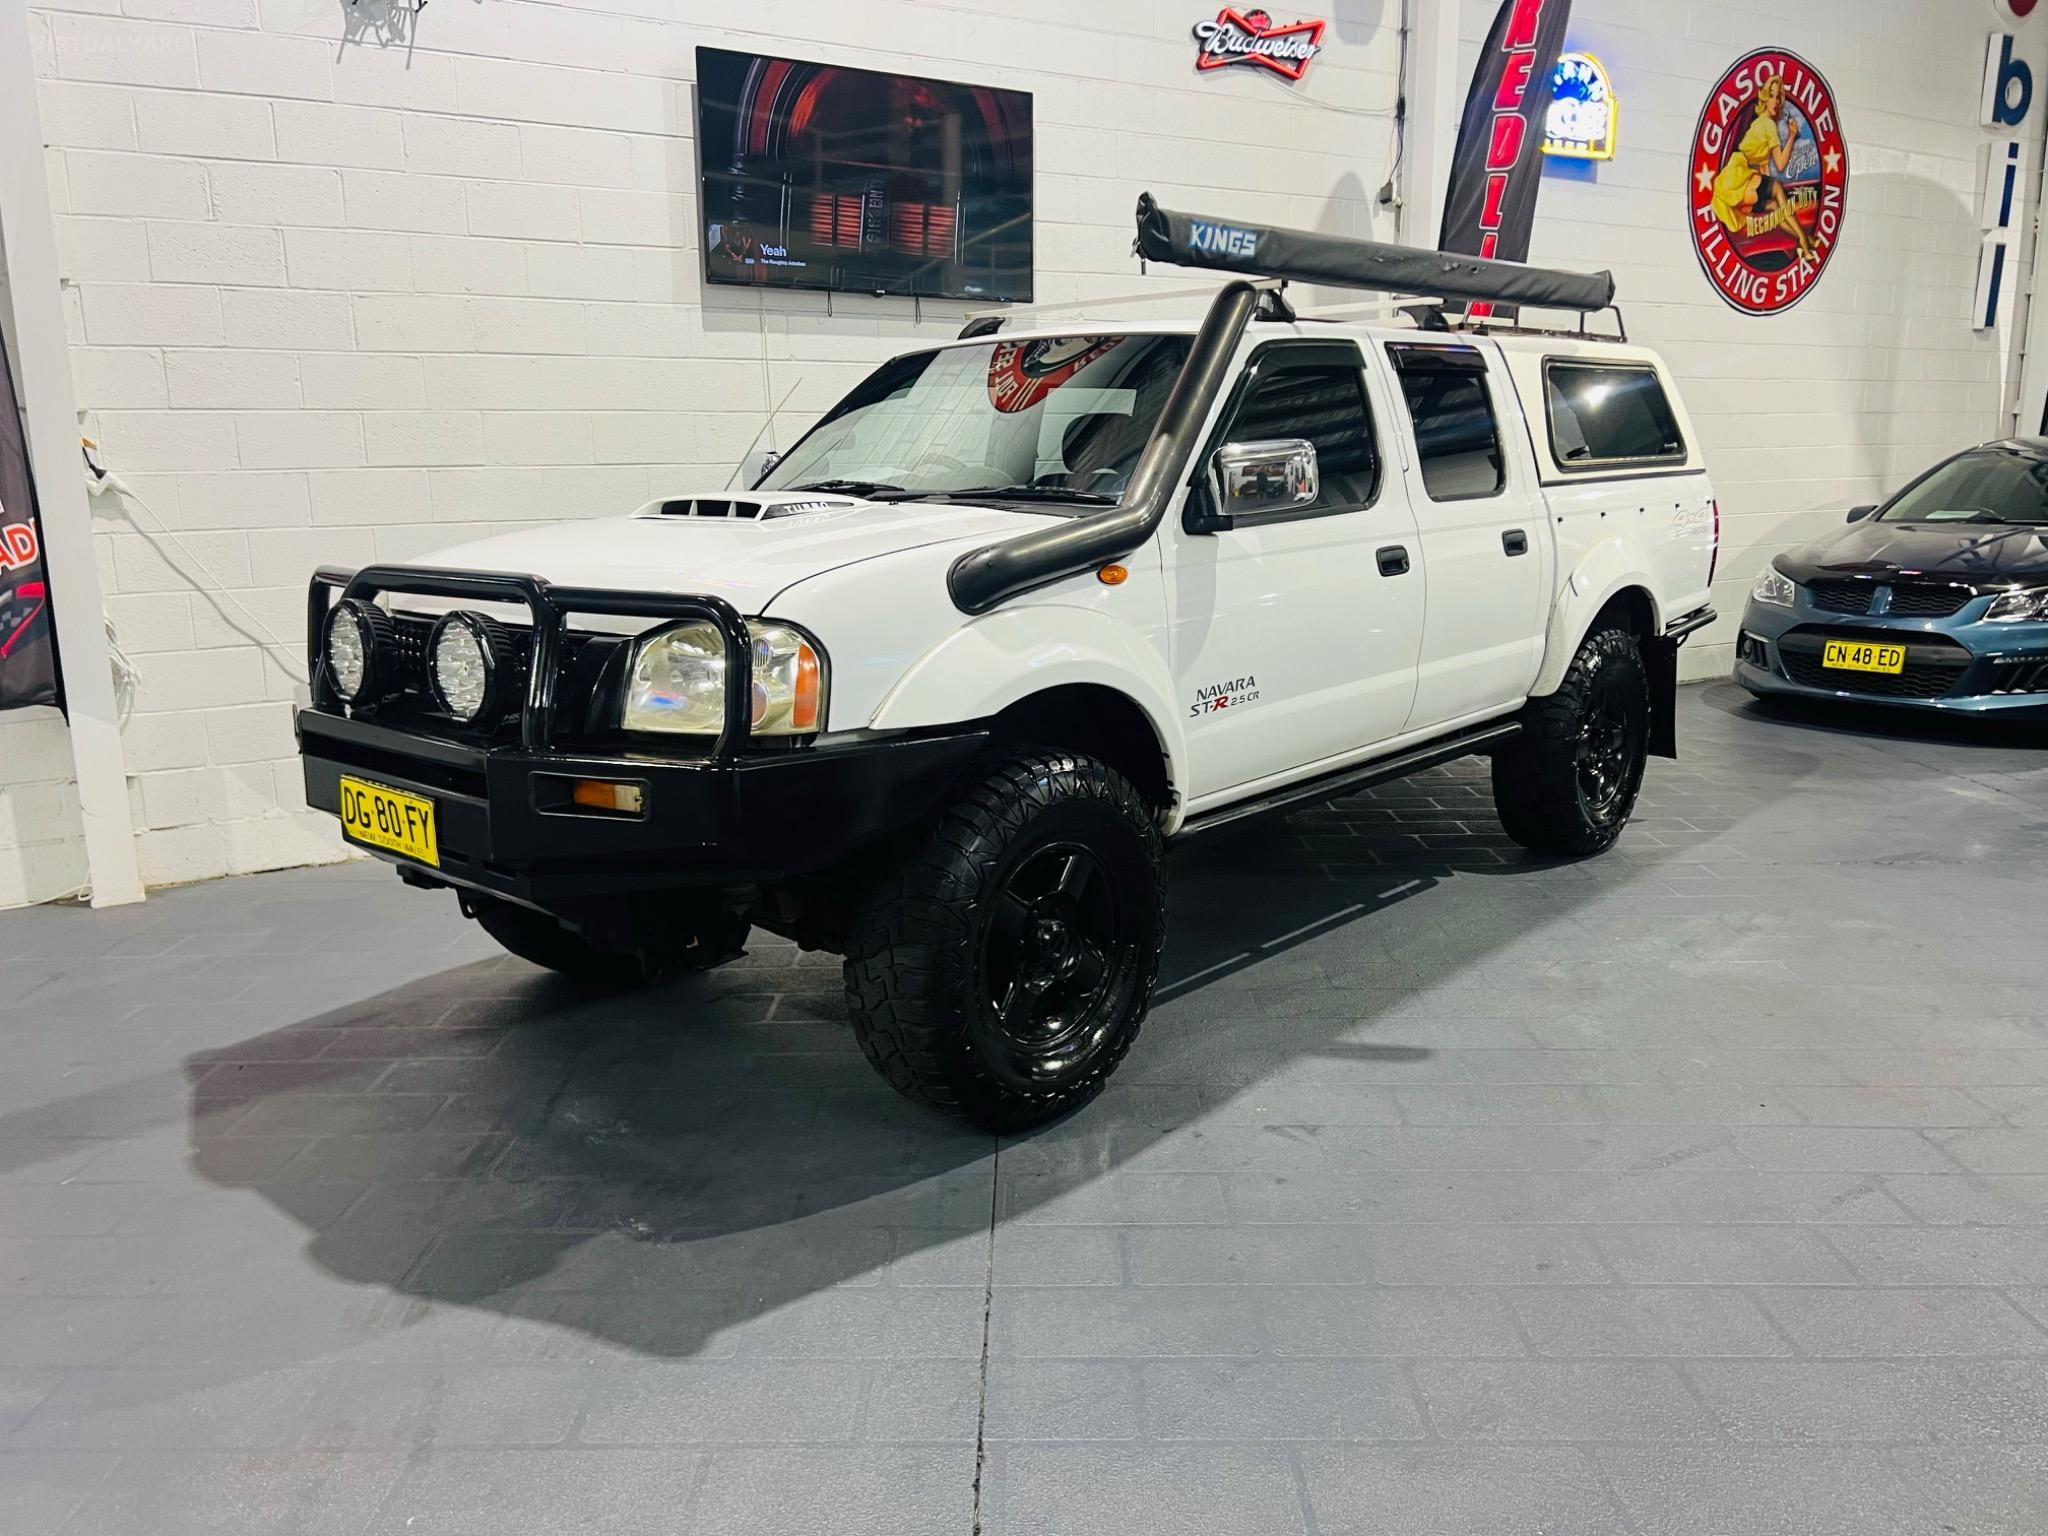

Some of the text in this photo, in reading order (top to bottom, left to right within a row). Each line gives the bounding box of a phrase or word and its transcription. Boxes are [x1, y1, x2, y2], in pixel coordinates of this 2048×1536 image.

[1195, 20, 1319, 60] Budweiser
[1702, 60, 1834, 155] GASOLINE
[1984, 0, 2037, 327] bil
[760, 243, 787, 257] Yeah
[1191, 224, 1257, 256] KINGS
[1697, 203, 1769, 304] FILLING
[783, 502, 830, 515] TURBO
[1196, 675, 1256, 702] NAVARA
[1189, 695, 1229, 718] ST-R
